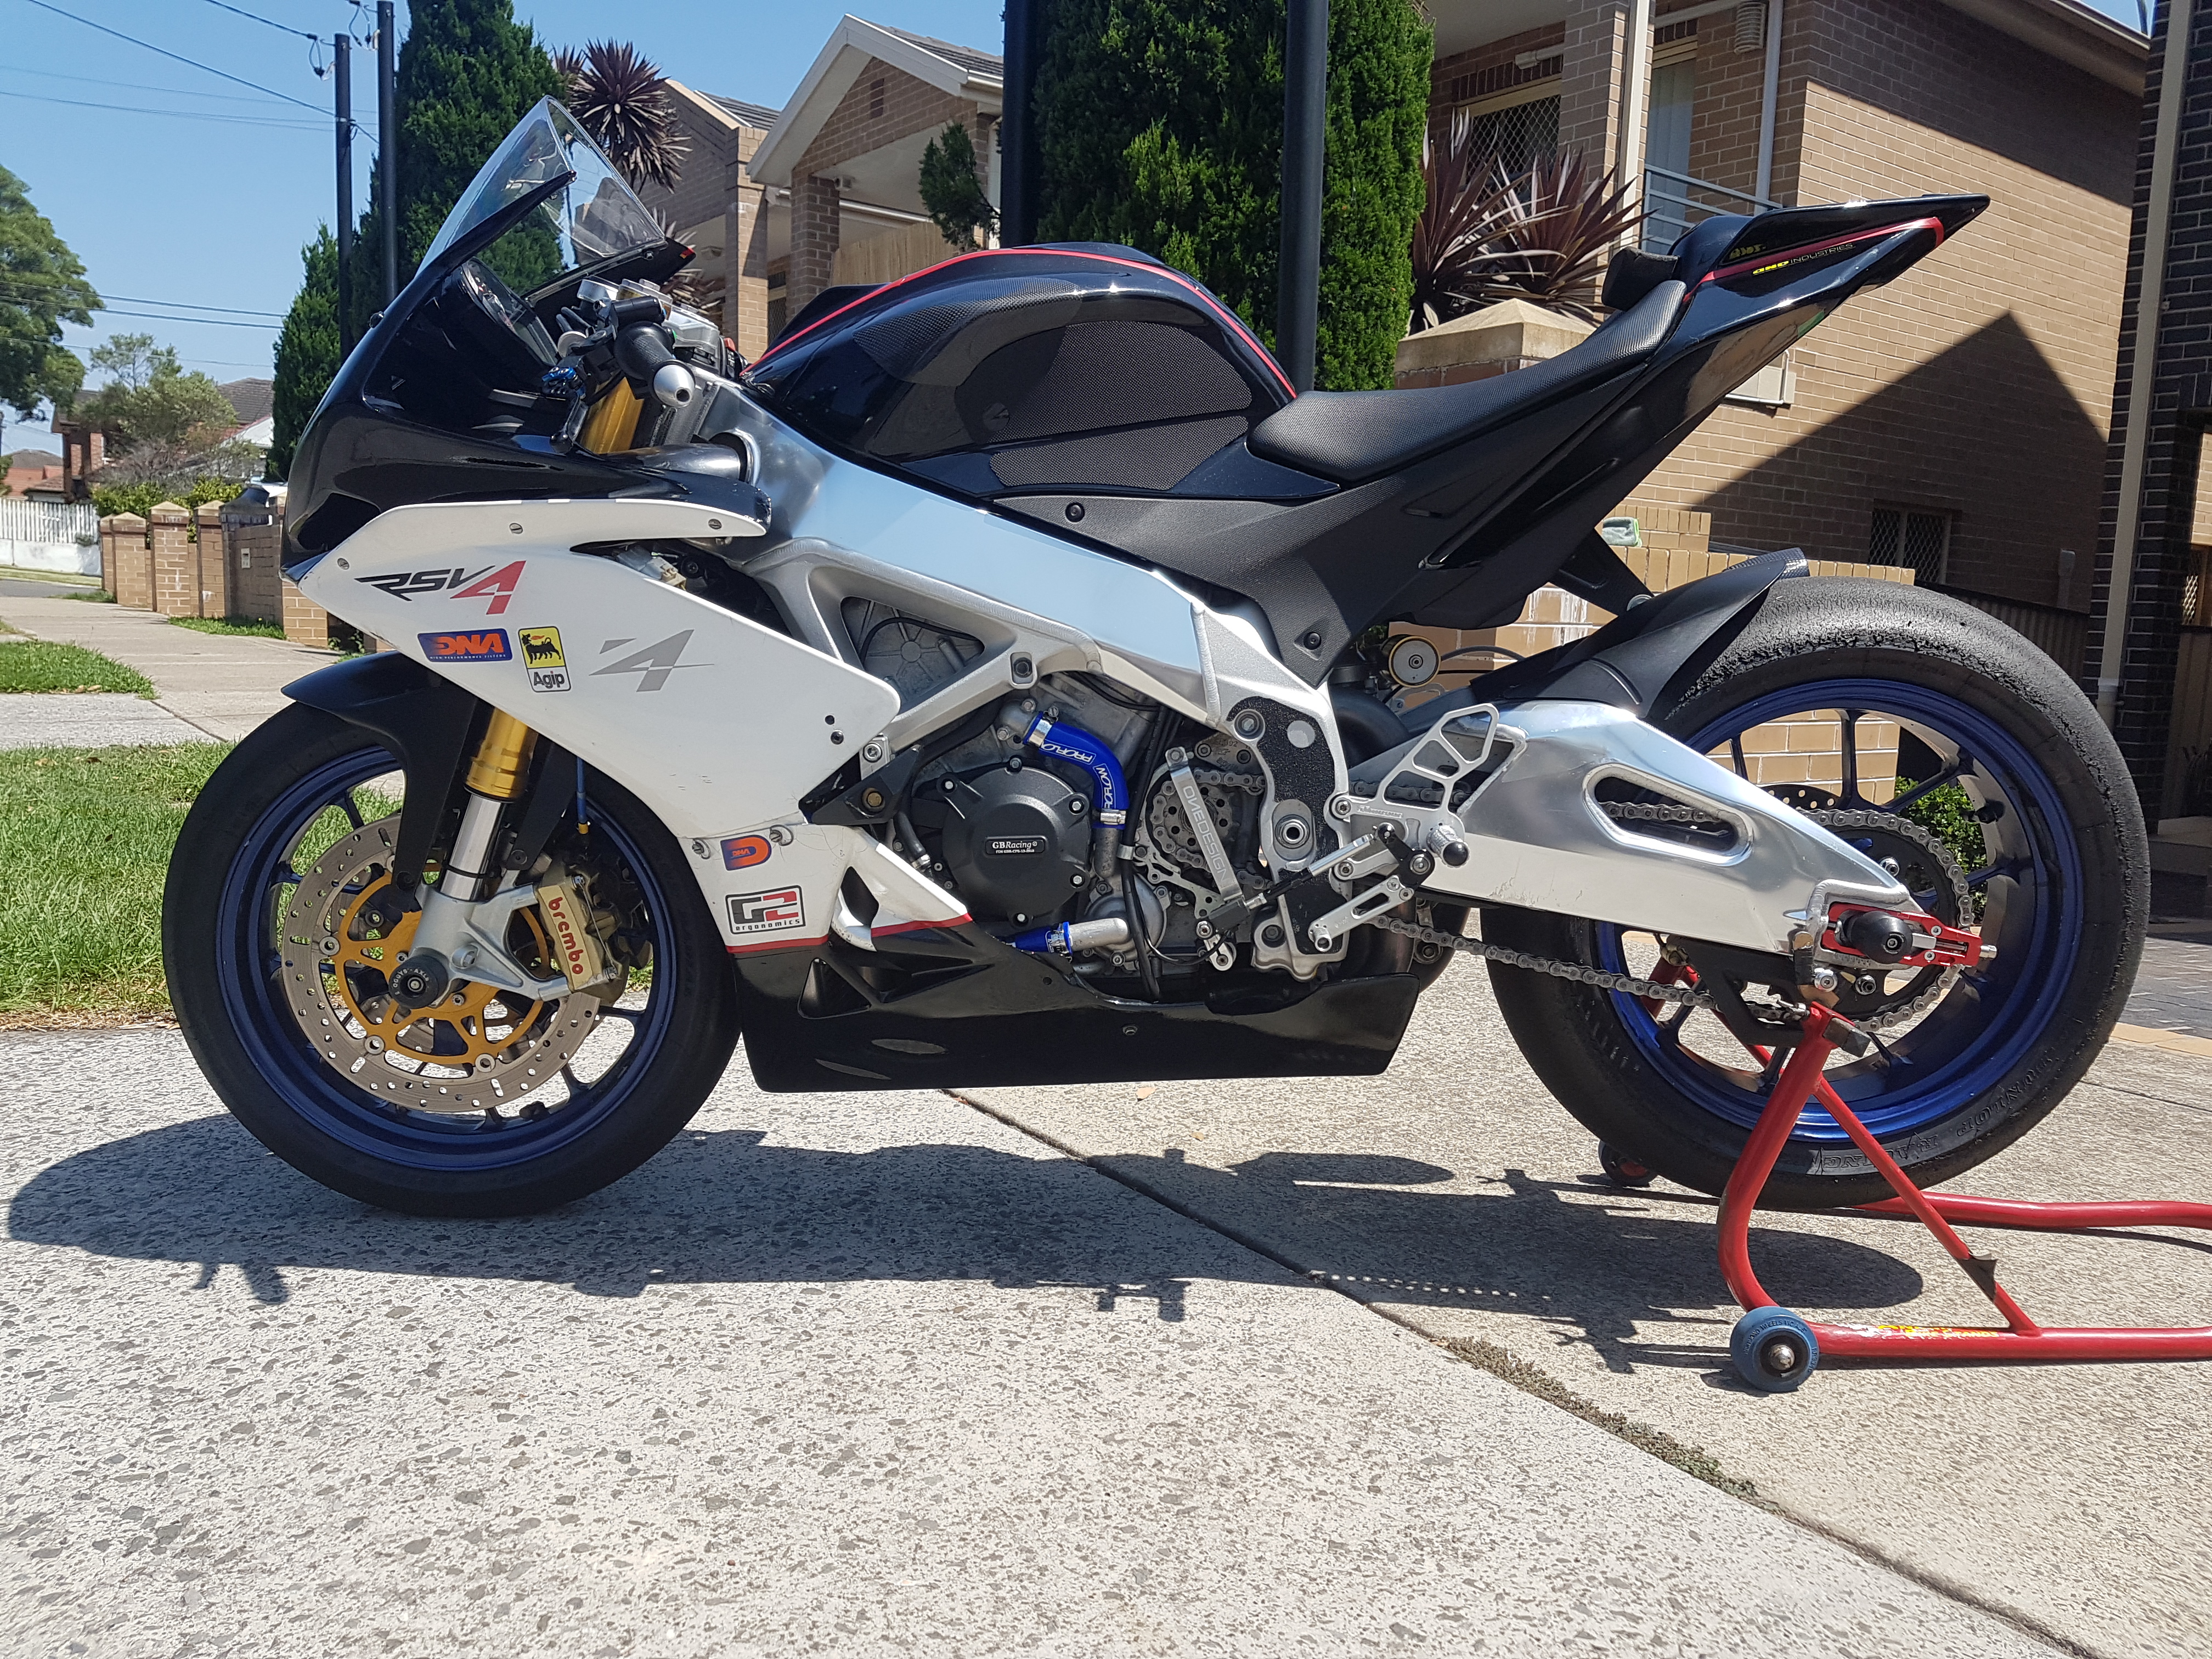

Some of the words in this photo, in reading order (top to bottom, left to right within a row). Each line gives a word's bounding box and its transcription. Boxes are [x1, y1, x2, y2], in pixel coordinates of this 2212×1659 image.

[1790, 242, 1854, 264] INDUSTRIES
[354, 560, 527, 615] RSV4
[435, 633, 504, 655] DNA
[533, 670, 565, 689] Agip
[1041, 742, 1093, 763] PROFLO
[1096, 768, 1113, 809] ROFLOW
[1183, 785, 1227, 882] ONEDESIGN
[549, 896, 584, 974] brembo
[736, 919, 800, 931] ergonomics
[1823, 1134, 1938, 1167] RAING
